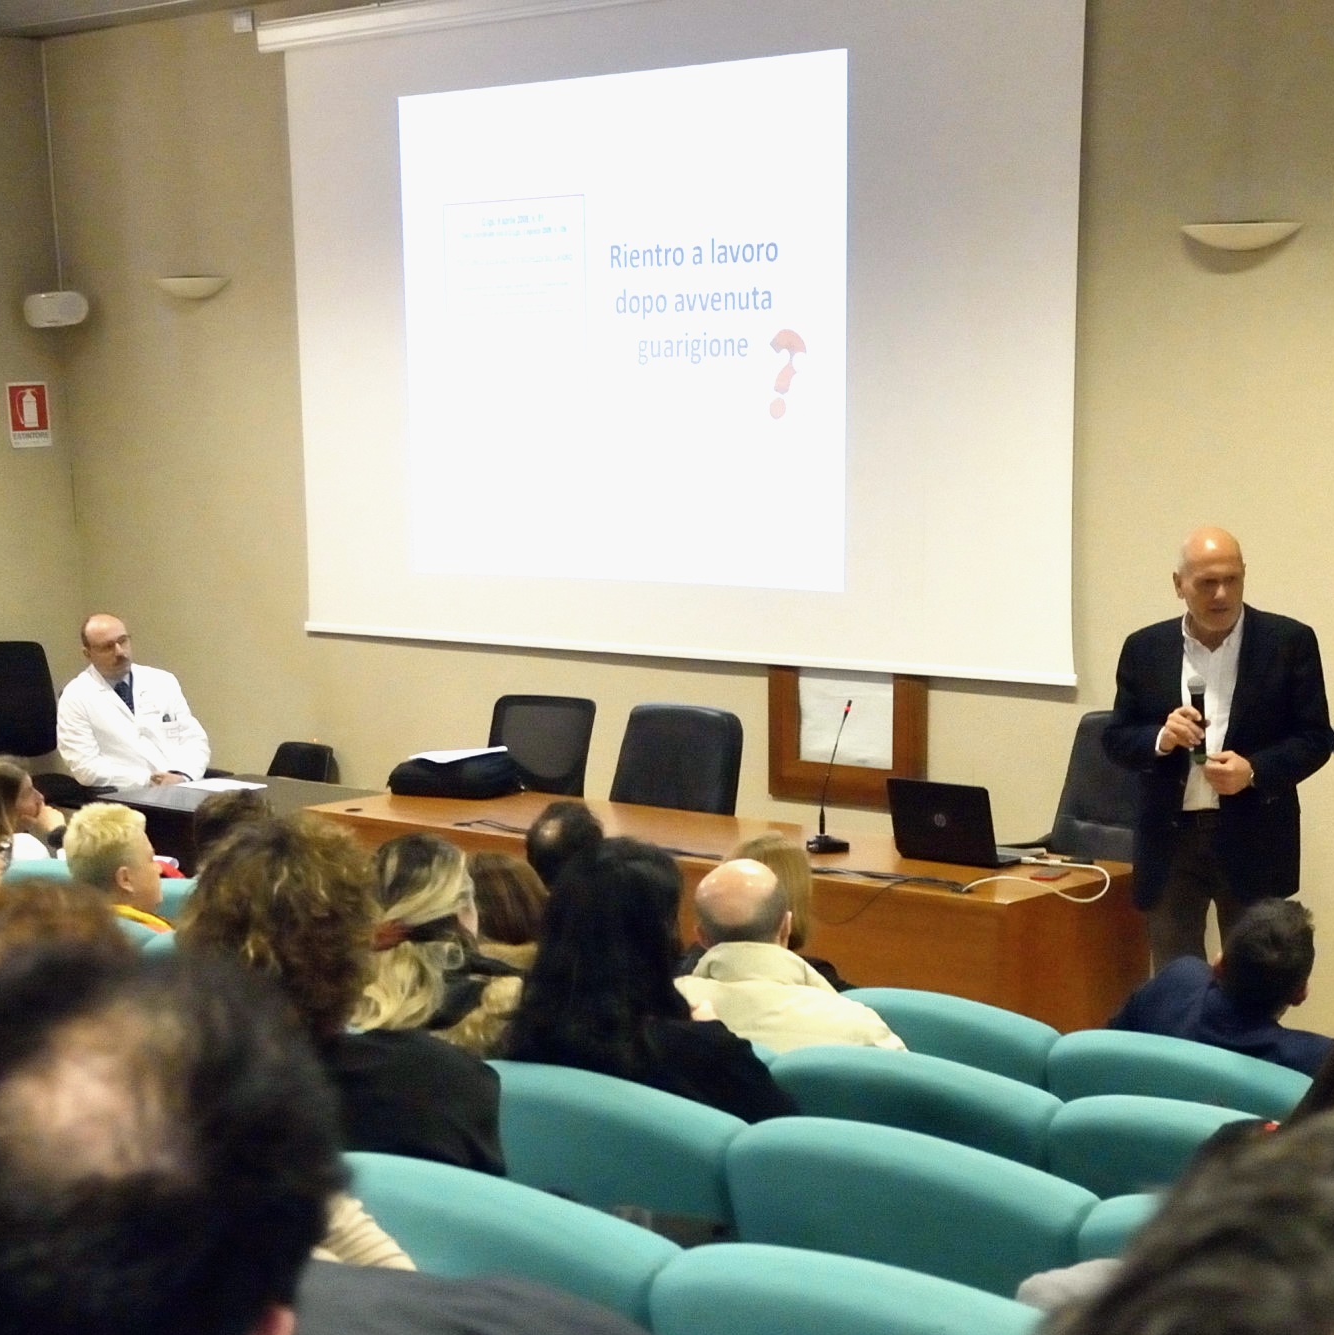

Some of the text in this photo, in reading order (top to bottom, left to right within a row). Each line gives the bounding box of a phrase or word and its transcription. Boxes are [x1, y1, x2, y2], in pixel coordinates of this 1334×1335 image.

[609, 237, 780, 270] Rientro a lavoro
[615, 285, 772, 320] dopo avvenuta
[637, 332, 749, 365] guarigione
